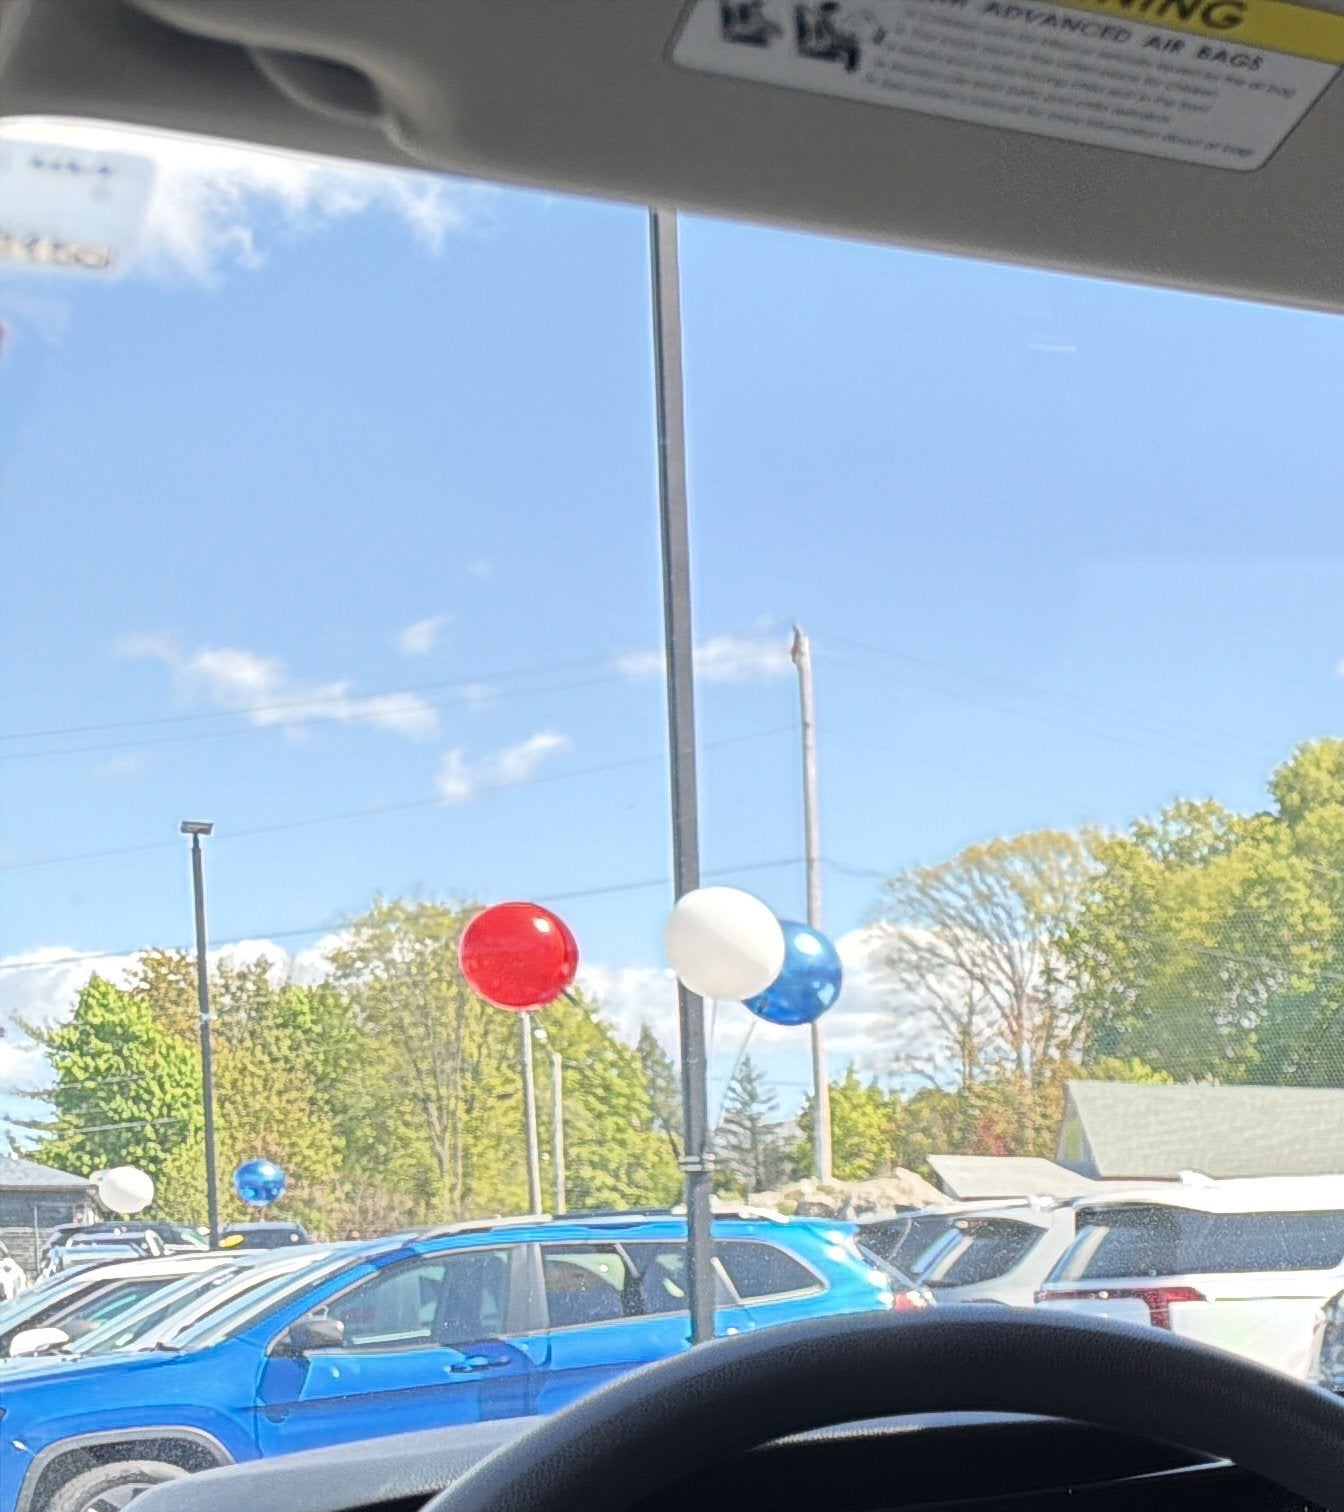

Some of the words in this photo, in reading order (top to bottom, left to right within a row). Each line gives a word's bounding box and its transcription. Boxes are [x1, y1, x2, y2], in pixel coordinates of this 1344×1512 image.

[984, 1, 1132, 43] ADVANCED
[1143, 34, 1186, 54] AIR
[1196, 44, 1265, 71] BAGS
